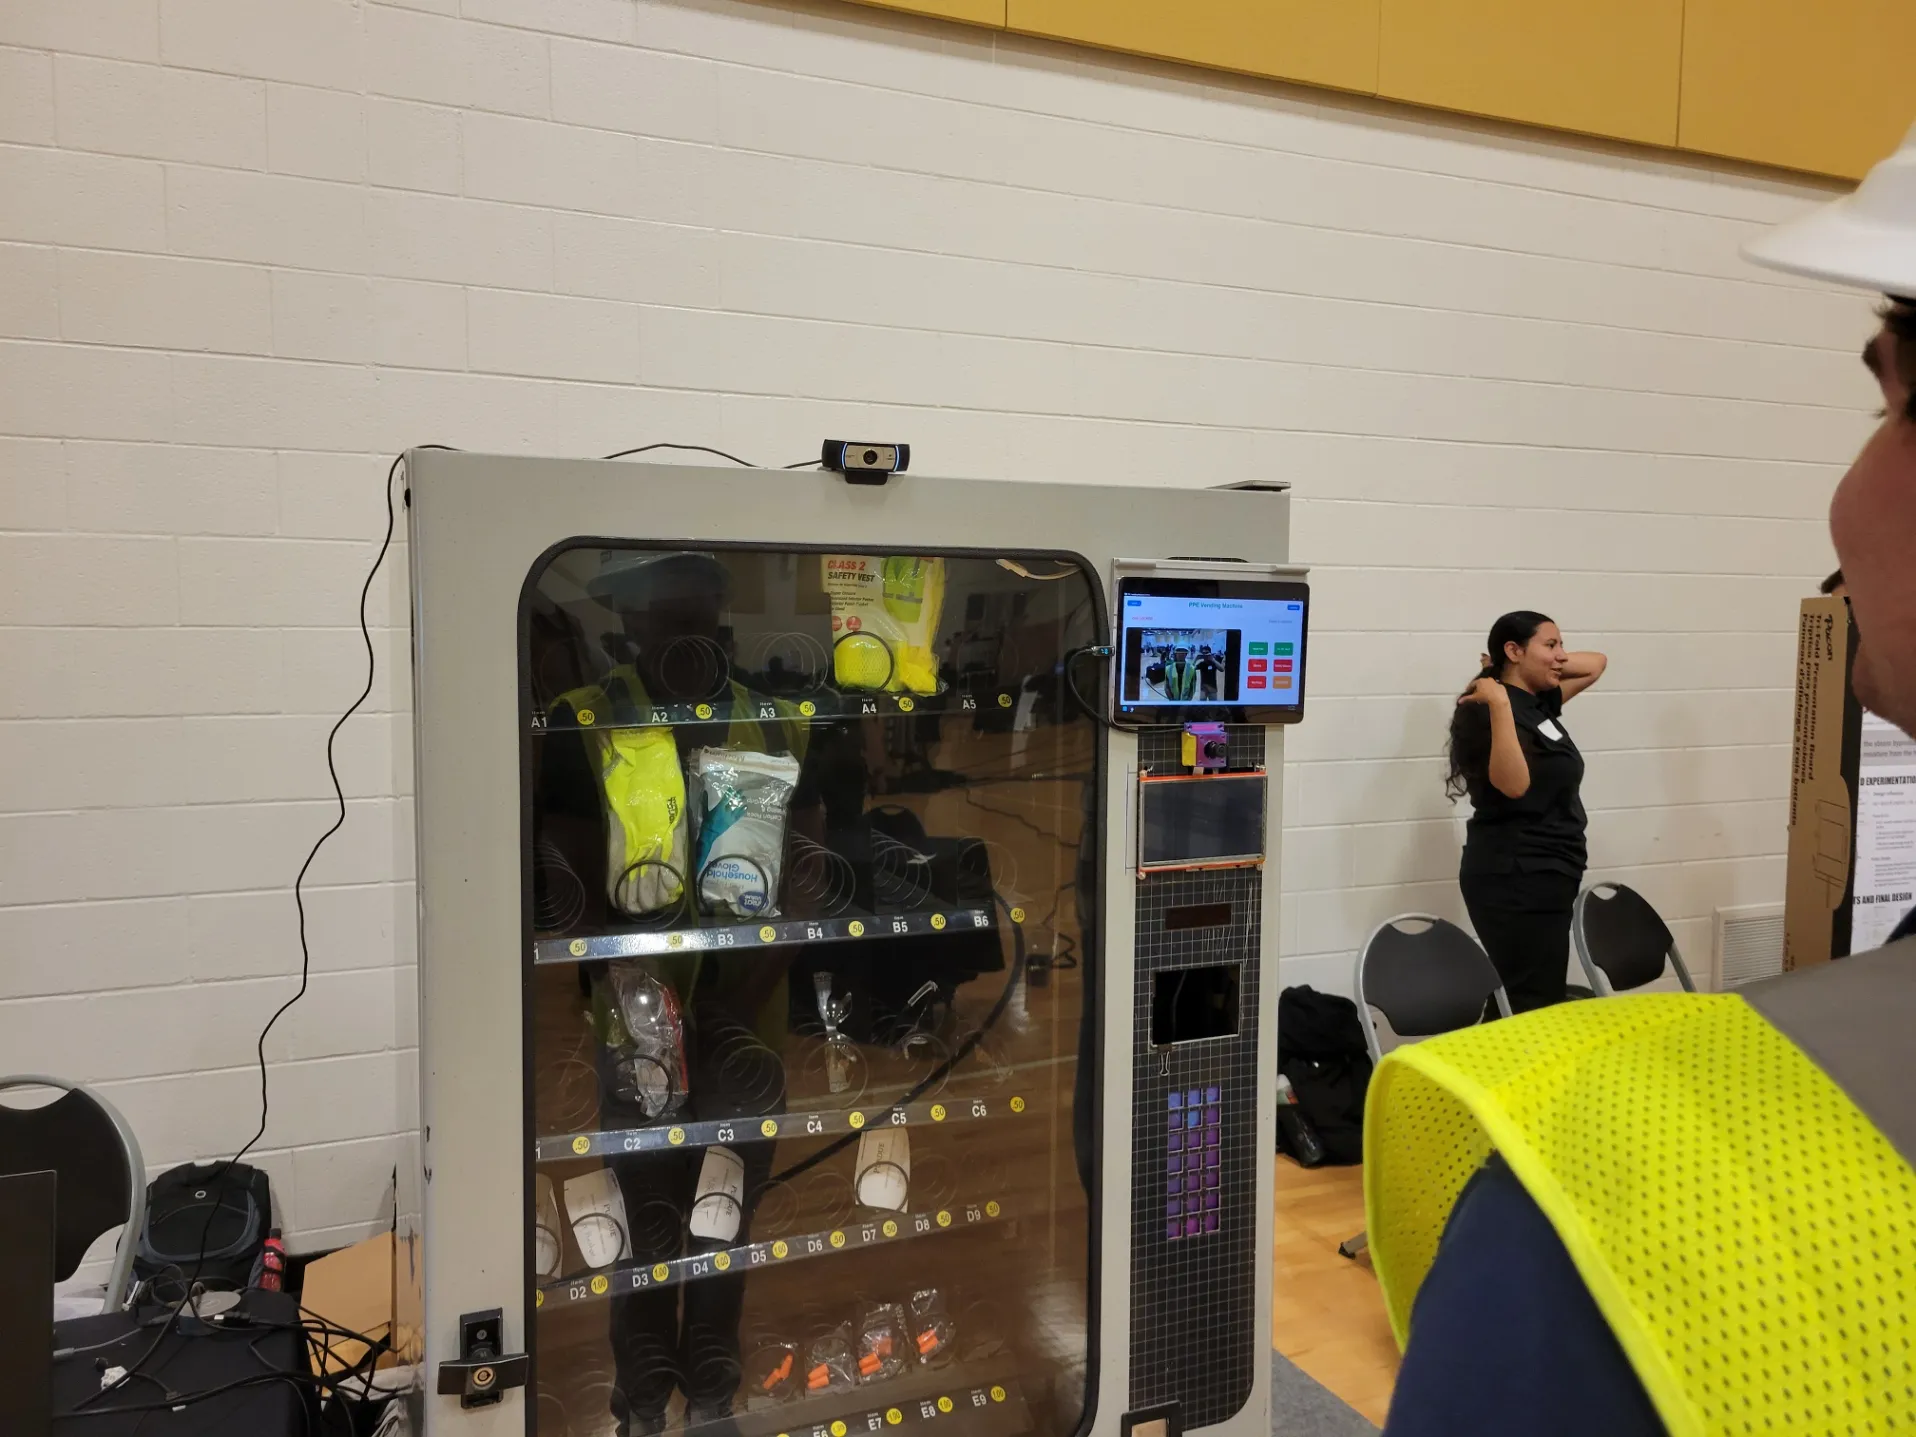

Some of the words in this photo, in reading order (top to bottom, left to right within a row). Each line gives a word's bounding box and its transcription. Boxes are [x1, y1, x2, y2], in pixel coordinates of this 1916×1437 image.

[827, 560, 857, 570] CLASS
[859, 561, 866, 571] 2
[827, 571, 857, 580] SAFETY
[857, 574, 875, 582] VEST
[1200, 602, 1221, 610] Vending
[1800, 613, 1808, 665] Panneau
[1824, 613, 1833, 661] Pacon
[901, 700, 913, 709] .50
[962, 699, 977, 710] A5
[1810, 662, 1819, 740] Presentation
[699, 707, 711, 716] .50
[760, 707, 776, 718] A3
[803, 704, 814, 713] .50
[862, 703, 877, 714] A4
[531, 717, 547, 728] A1
[580, 712, 593, 722] .50
[651, 711, 669, 722] A2
[1801, 693, 1809, 784] presentaciones
[1866, 775, 1916, 786] EXPERIMENTATIO
[1792, 778, 1800, 826] battants
[706, 869, 758, 882] Household
[1862, 895, 1875, 904] AND
[1876, 894, 1891, 903] FINAL
[1891, 892, 1912, 901] DESIGN
[933, 917, 945, 926] .50
[973, 915, 989, 927] B6
[1013, 911, 1024, 920] .50
[807, 927, 823, 939] B4
[851, 924, 863, 933] .50
[892, 921, 908, 933] B5
[717, 934, 734, 946] B3
[762, 929, 775, 939] .50
[573, 940, 586, 952] .50
[534, 948, 539, 960] 1
[1013, 1100, 1024, 1108] .50
[933, 1108, 945, 1117] .50
[972, 1104, 987, 1117] C6
[852, 1115, 863, 1124] .50
[891, 1112, 907, 1125] C5
[763, 1122, 776, 1132] .50
[806, 1120, 823, 1133] C4
[671, 1131, 684, 1141] .50
[717, 1129, 734, 1142] C3
[575, 1139, 589, 1151] .50
[623, 1137, 641, 1151] C2
[535, 1146, 541, 1159] 1
[966, 1209, 981, 1222] D9
[915, 1219, 930, 1232] D8
[862, 1229, 877, 1242] D7
[807, 1239, 823, 1253] D6
[716, 1254, 729, 1266] 1.00
[751, 1250, 767, 1264] D5
[654, 1266, 667, 1277] 1.00
[692, 1262, 709, 1275] D4
[593, 1277, 606, 1289] 1.00
[632, 1273, 649, 1287] D3
[569, 1286, 587, 1300] D2
[971, 1394, 987, 1407] E9
[920, 1405, 936, 1418] E8
[867, 1417, 882, 1431] E7
